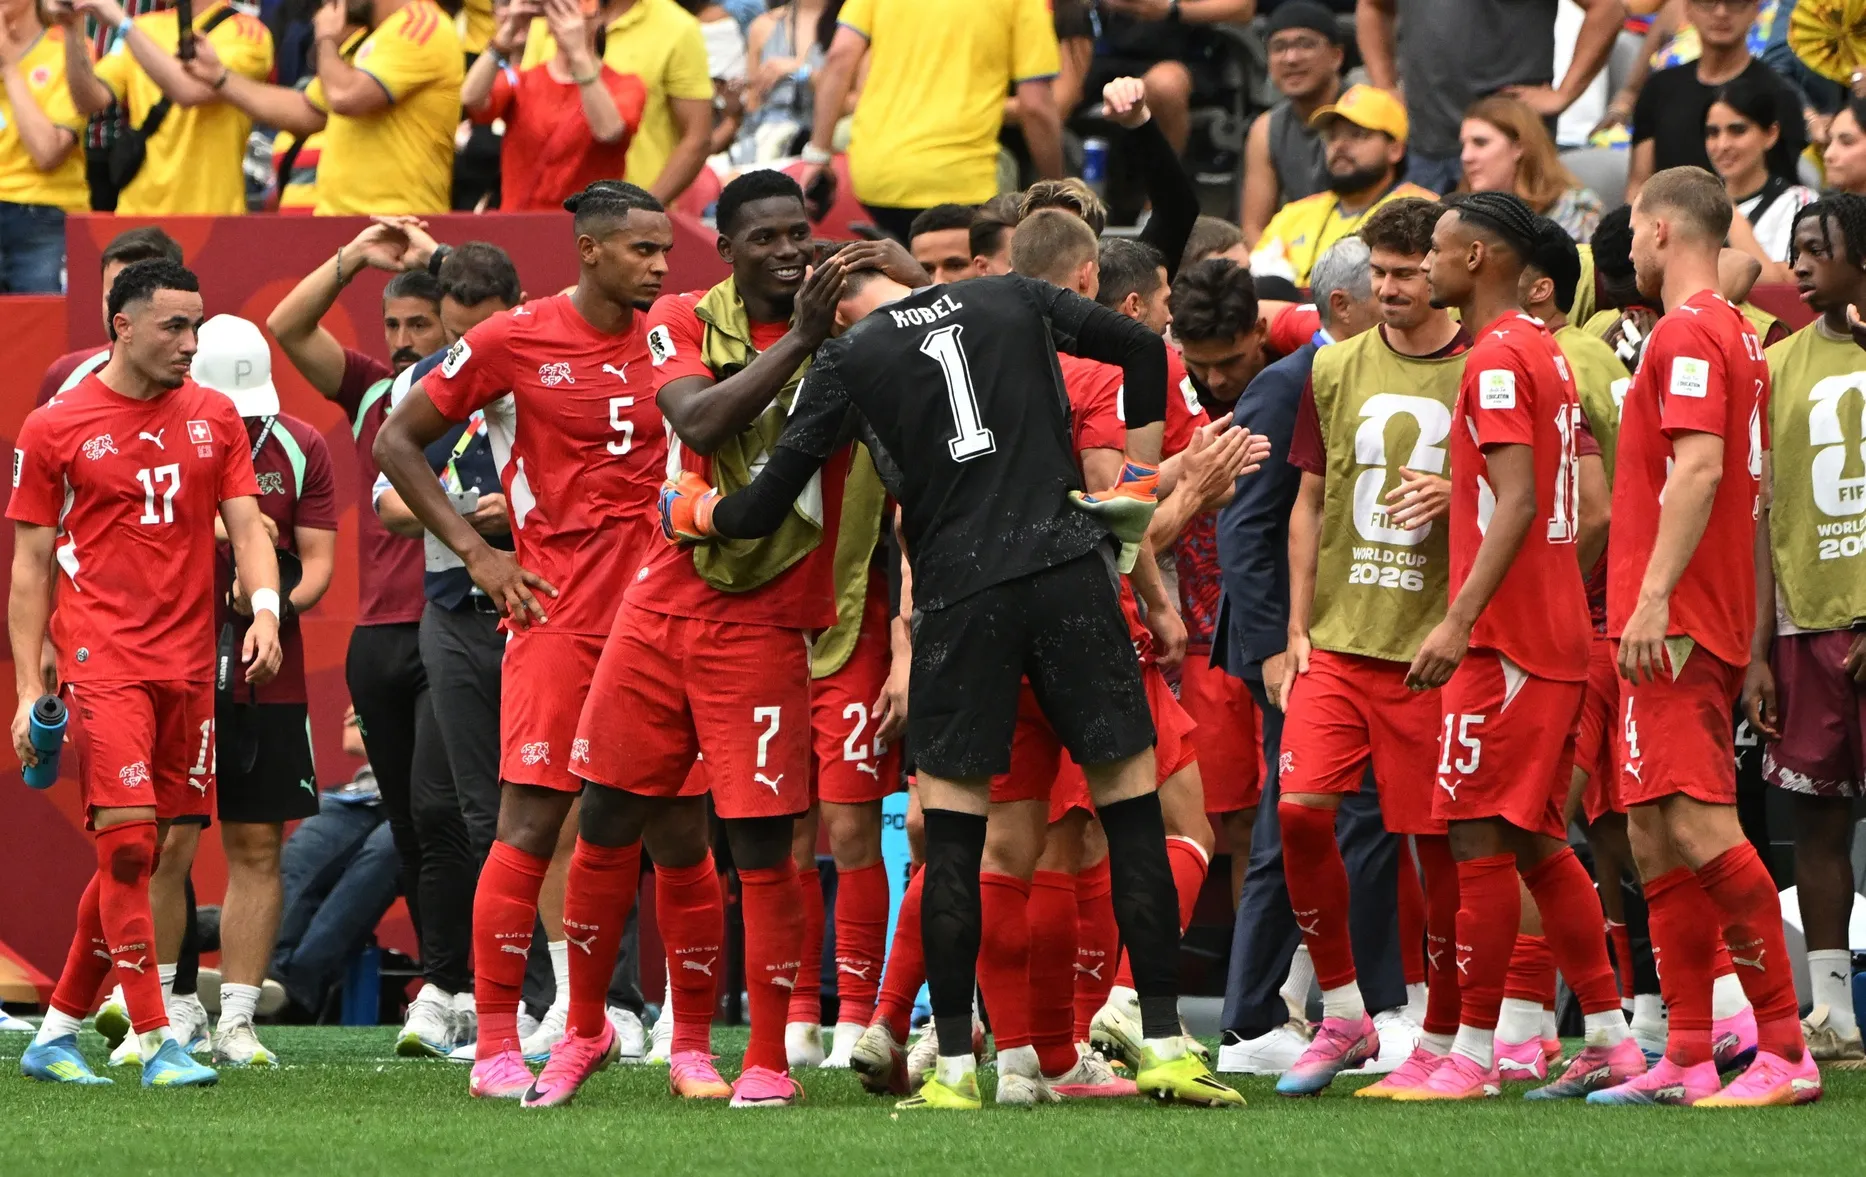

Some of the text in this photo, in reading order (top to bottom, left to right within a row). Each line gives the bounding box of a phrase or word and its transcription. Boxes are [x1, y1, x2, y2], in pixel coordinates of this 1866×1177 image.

[889, 293, 963, 329] KOBEL
[234, 359, 252, 386] P
[919, 323, 996, 463] 1
[606, 396, 635, 456] 5
[135, 462, 181, 524] 17
[1838, 485, 1866, 502] FIF
[1817, 516, 1866, 538] WORL
[1352, 546, 1428, 568] WORLD CUP
[1348, 562, 1424, 592] 2026
[217, 656, 229, 691] Canon
[753, 705, 781, 768] 7
[1437, 713, 1487, 774] 15
[1625, 696, 1641, 759] 4
[189, 717, 216, 775] 1
[765, 960, 801, 971] suiss
[1078, 947, 1105, 957] isse
